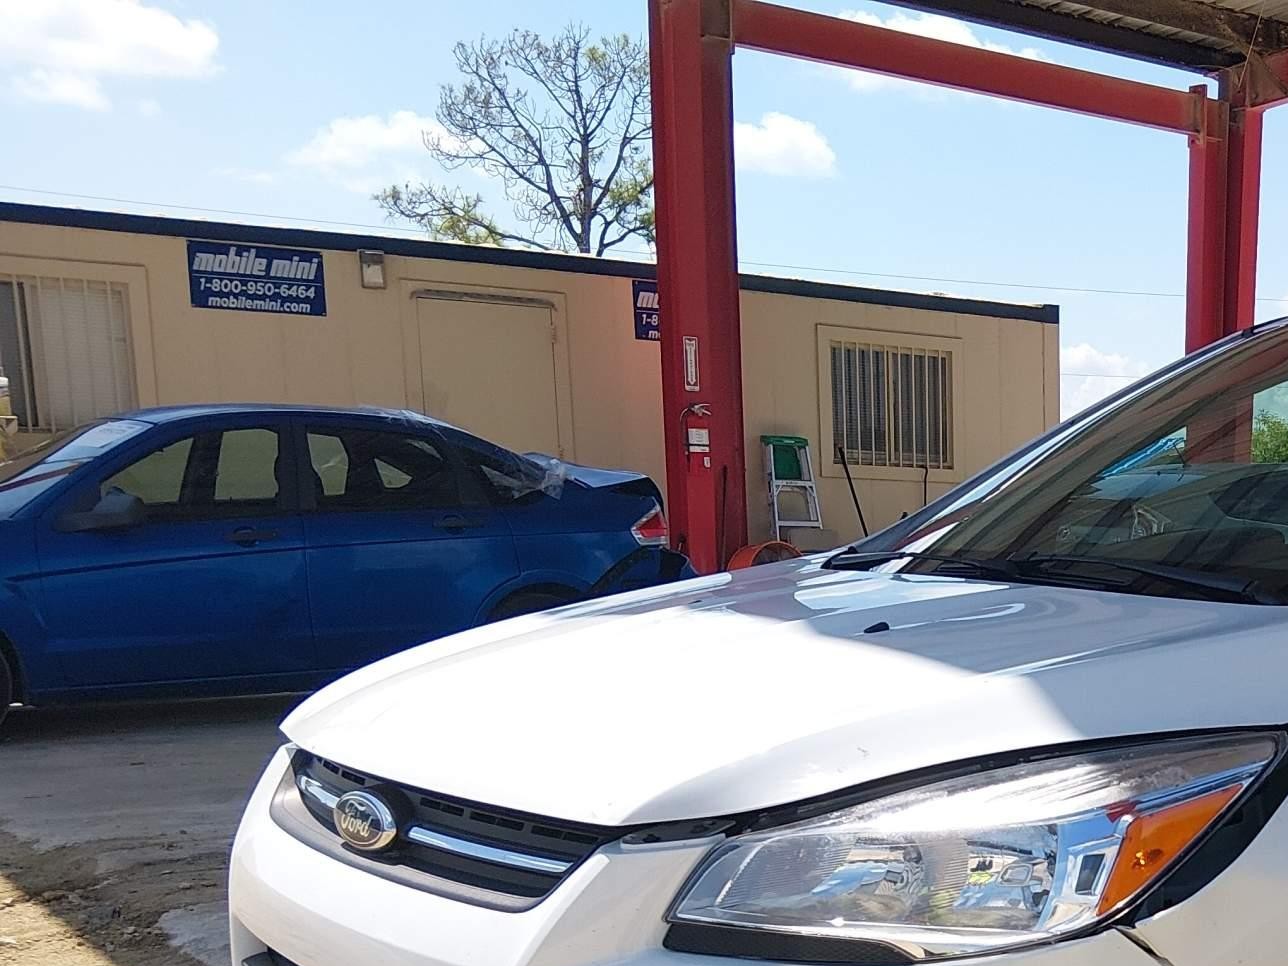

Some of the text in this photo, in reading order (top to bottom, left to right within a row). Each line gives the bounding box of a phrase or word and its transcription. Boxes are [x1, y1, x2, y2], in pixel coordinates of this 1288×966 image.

[193, 246, 319, 280] mobile mini
[199, 278, 316, 299] 1-800-950-6464
[208, 296, 311, 313] mobilemini.com
[341, 800, 372, 838] Ford
